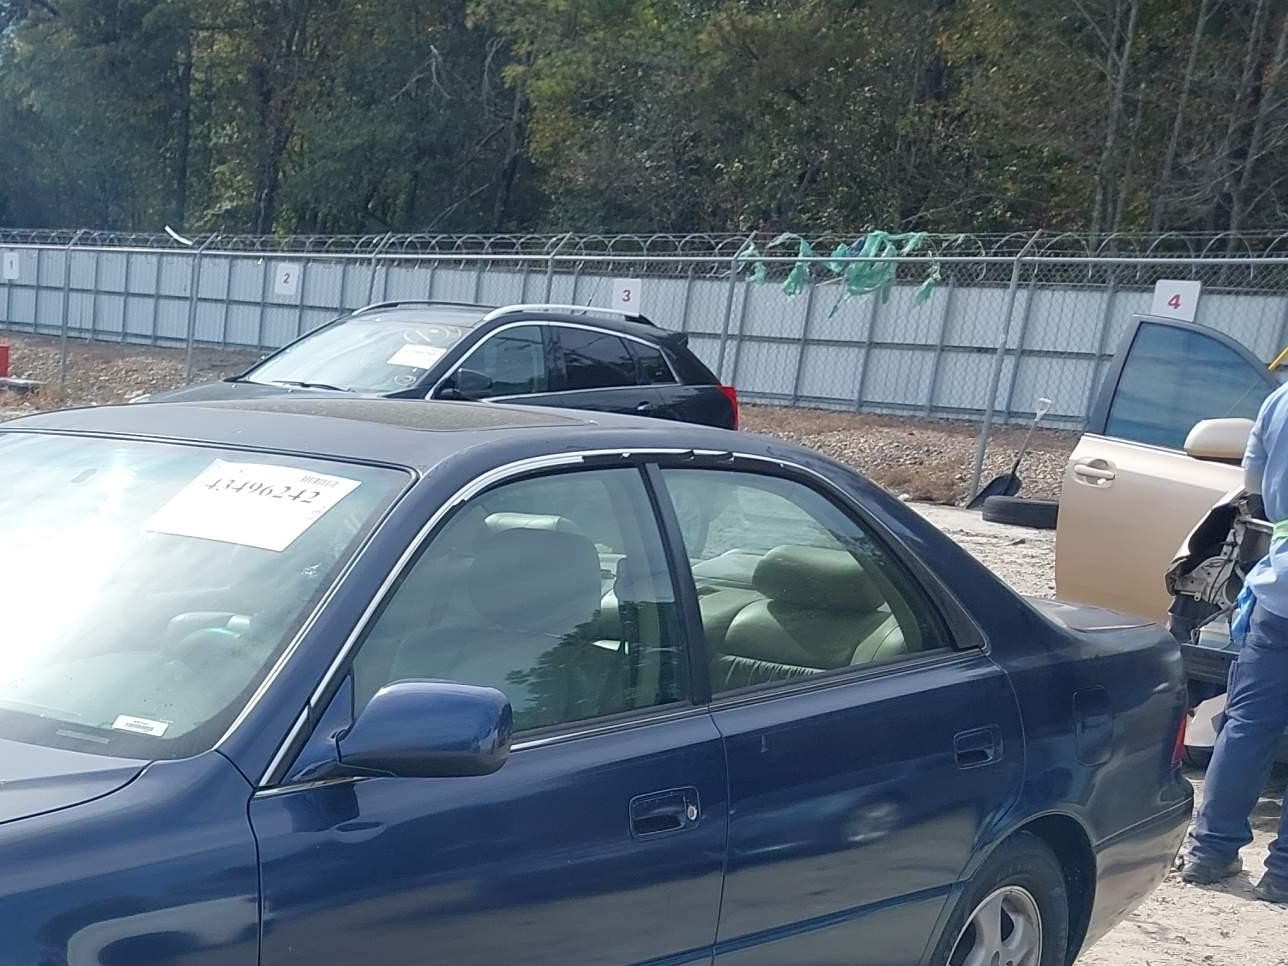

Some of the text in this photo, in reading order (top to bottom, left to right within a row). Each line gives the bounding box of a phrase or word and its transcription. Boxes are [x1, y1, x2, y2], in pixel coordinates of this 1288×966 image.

[283, 272, 290, 284] 2
[622, 289, 631, 302] 3
[1167, 294, 1181, 310] 4
